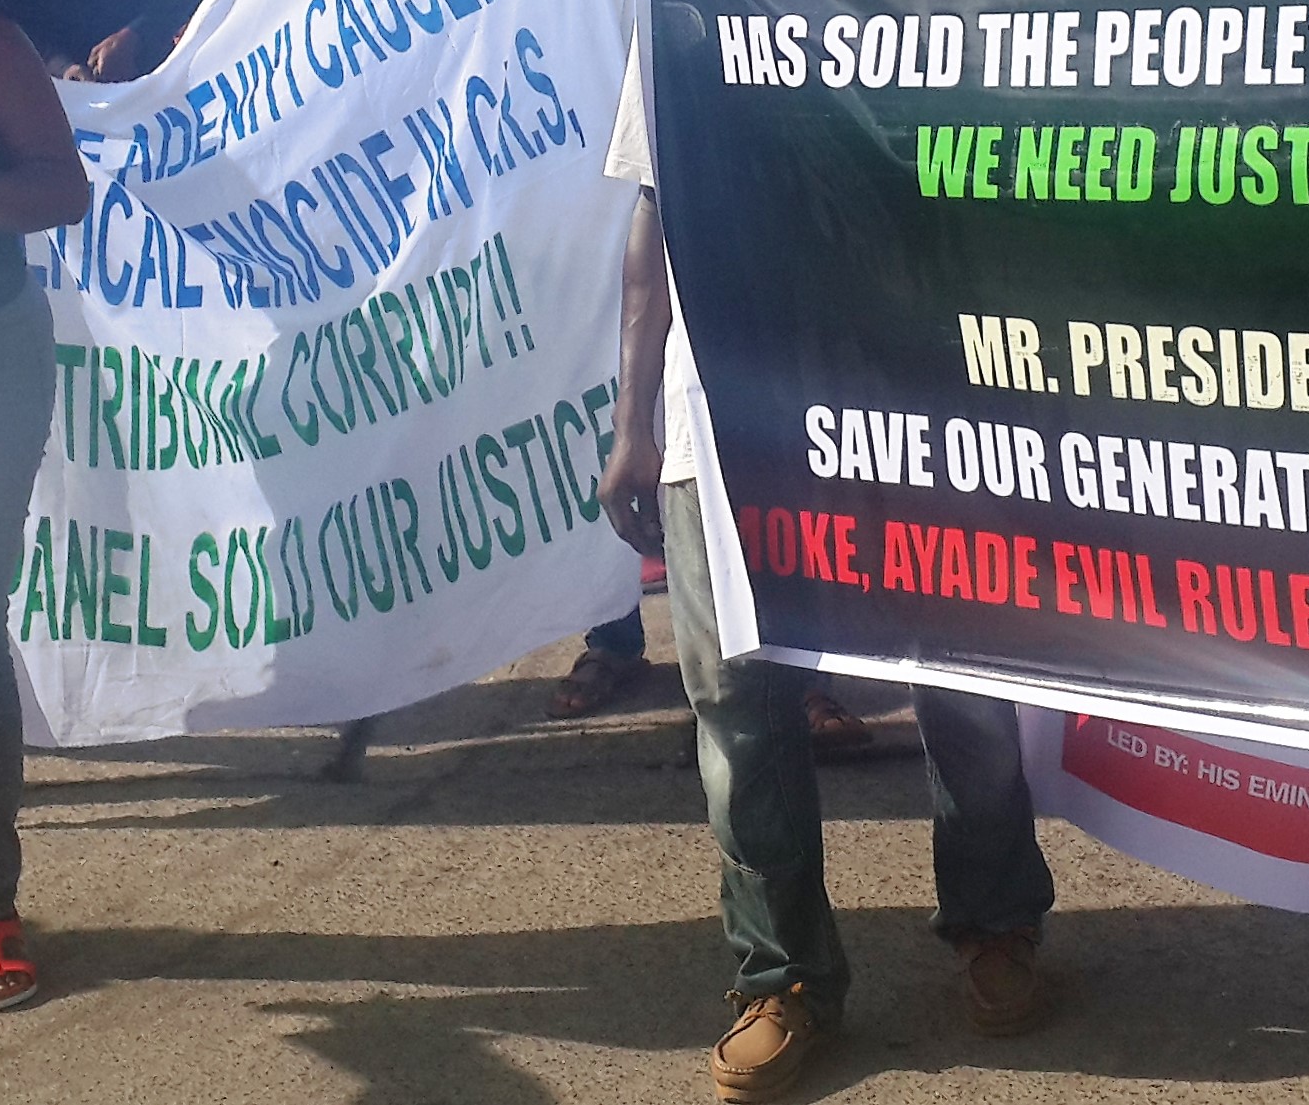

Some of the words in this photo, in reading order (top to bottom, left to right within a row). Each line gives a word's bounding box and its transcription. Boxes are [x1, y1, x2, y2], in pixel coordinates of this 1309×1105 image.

[717, 12, 814, 90] HAS
[819, 9, 965, 91] SOLD
[977, 7, 1083, 90] THE
[117, 20, 307, 186] ADENIYI
[403, 97, 474, 221] IN
[915, 124, 1006, 201] WE
[1014, 124, 1158, 204] NEED
[54, 339, 284, 472] TRIBUNAL
[281, 231, 537, 448] CORRUPT!!
[956, 310, 1061, 396] MR.
[803, 404, 936, 494] SAVE
[944, 420, 1053, 506] OUR
[185, 515, 315, 652] SOLD
[319, 476, 434, 624] OUR
[883, 519, 1041, 611] AYADE
[1052, 540, 1168, 629] EVIL
[1106, 724, 1148, 759] LED
[1153, 744, 1190, 776] BY:
[1197, 759, 1241, 792] HIS
